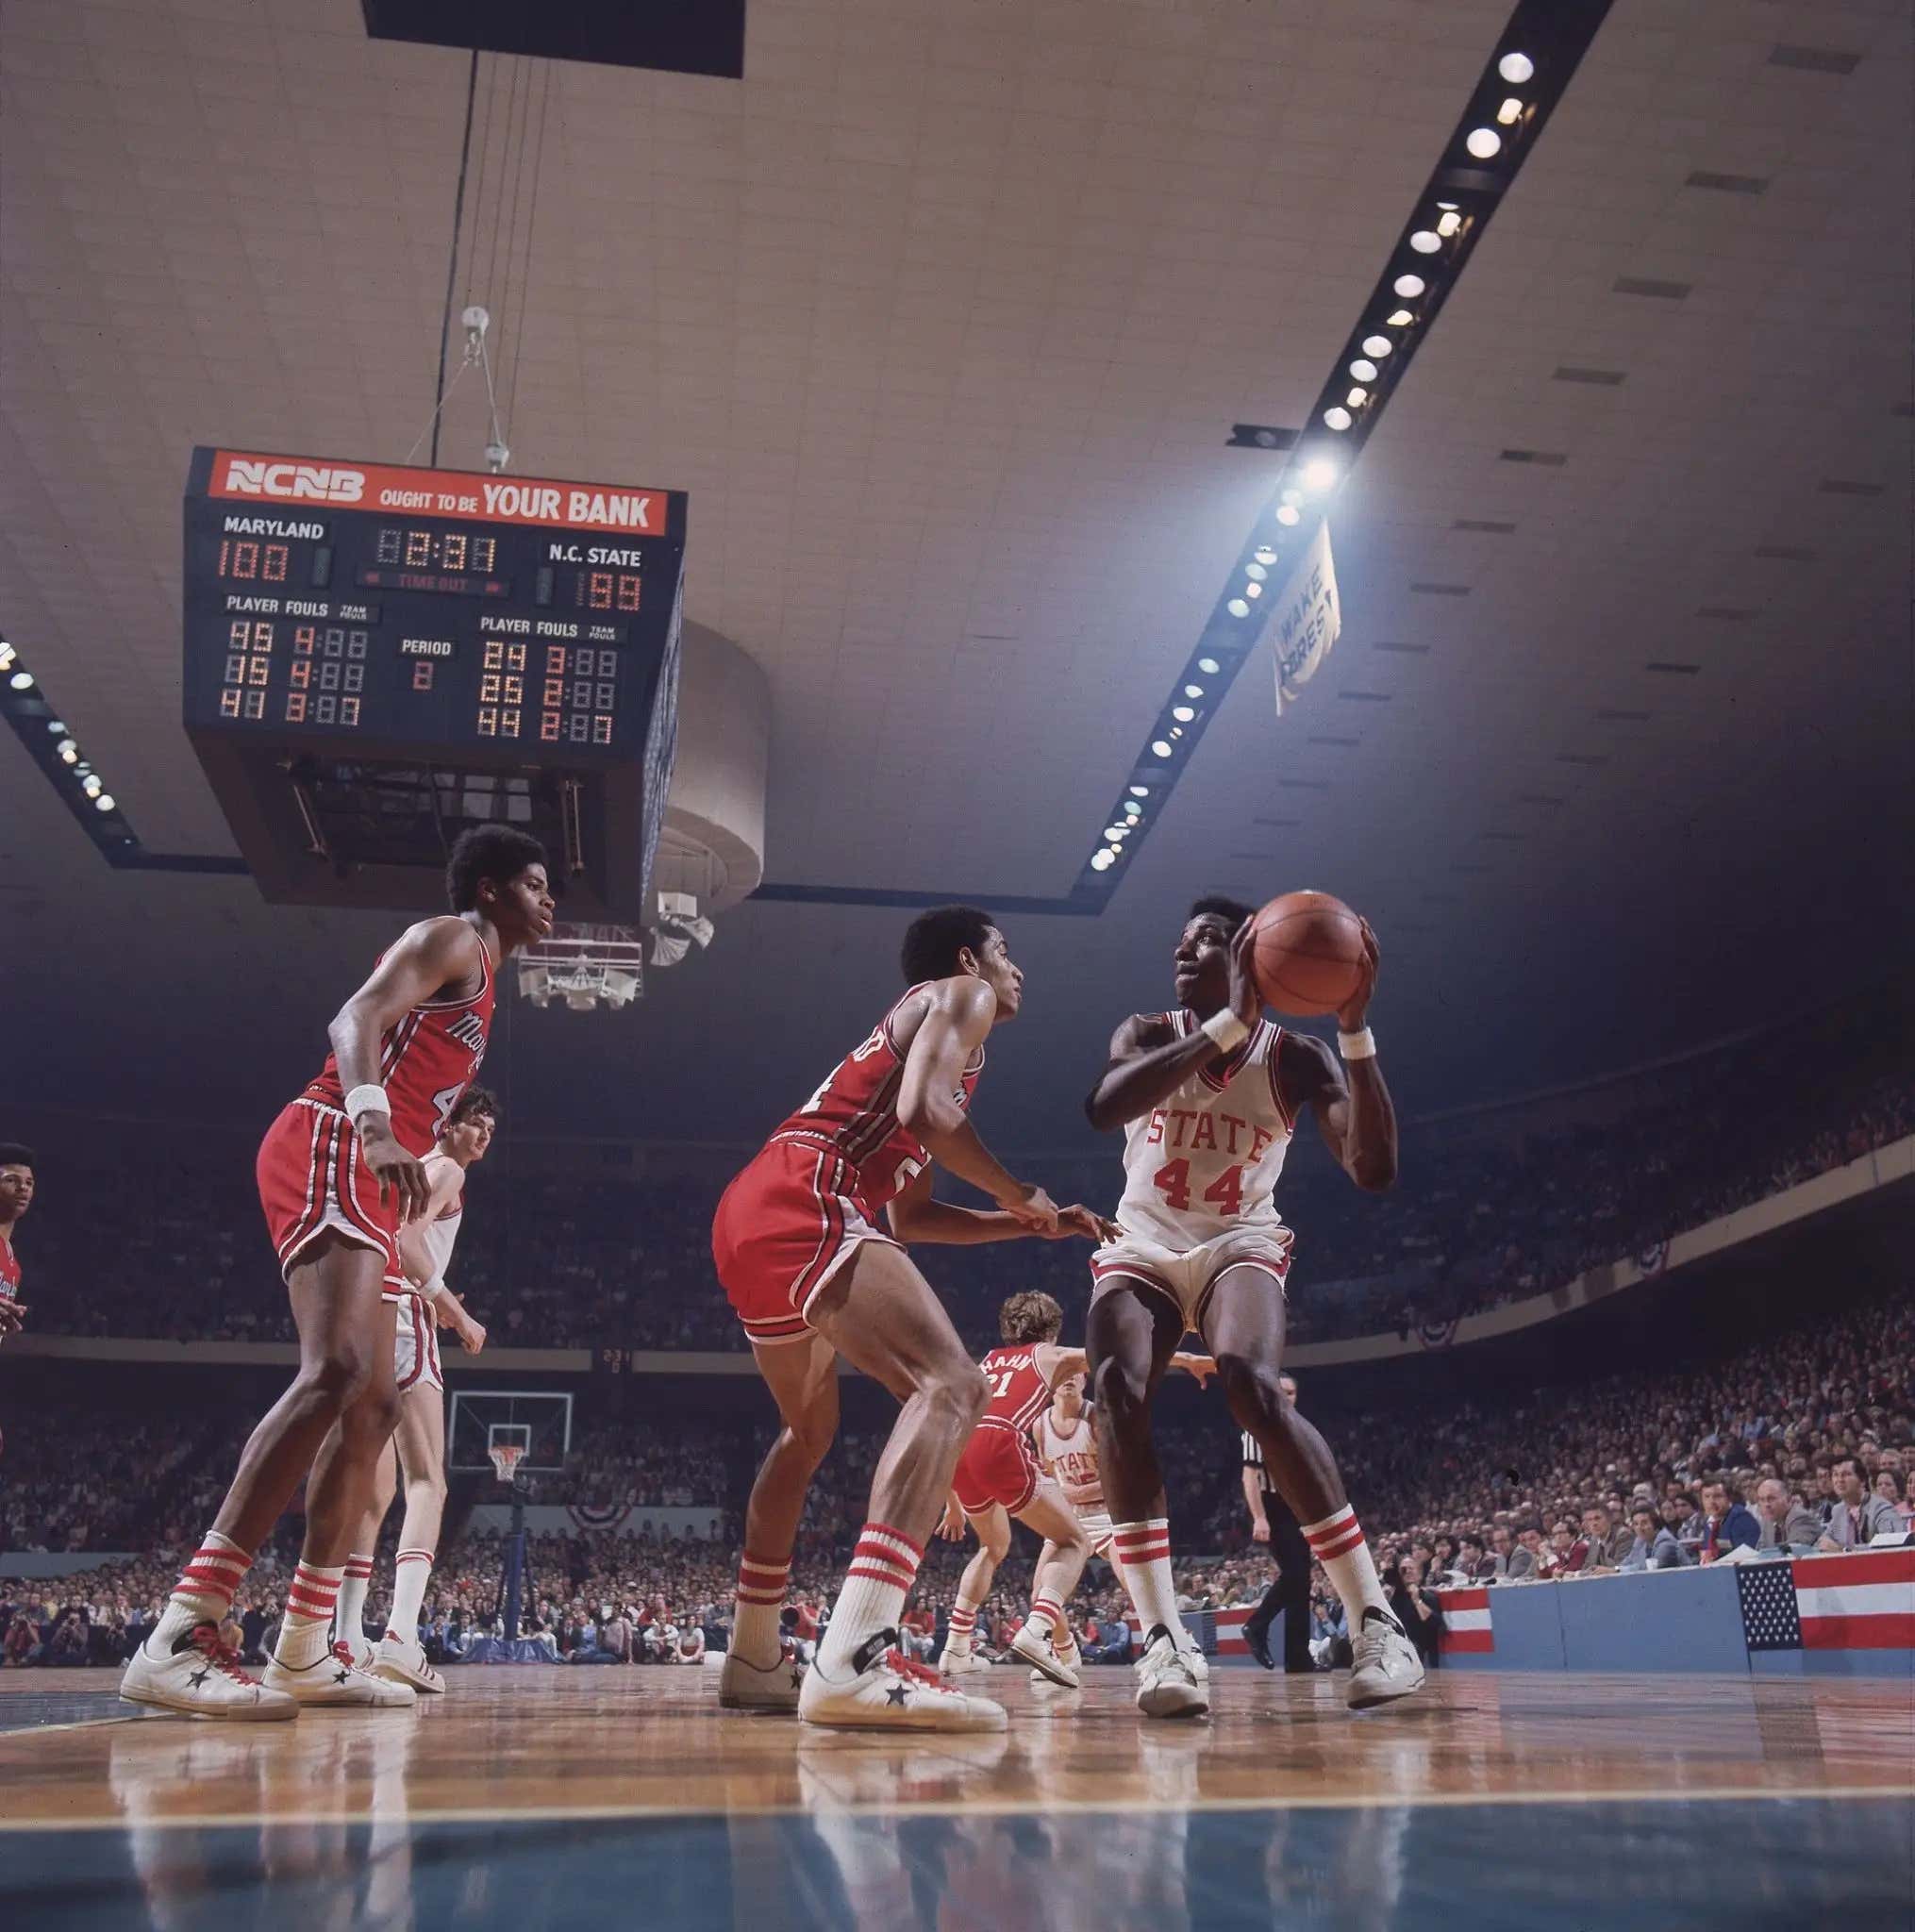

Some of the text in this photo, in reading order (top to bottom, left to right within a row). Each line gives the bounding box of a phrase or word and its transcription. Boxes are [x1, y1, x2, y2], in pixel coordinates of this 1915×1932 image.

[225, 460, 651, 527] NCNB OUGHT TO BE YOUR BANK
[224, 516, 325, 540] MARYLAND
[218, 541, 289, 581] 100
[549, 543, 642, 567] N.C. STATE
[226, 595, 329, 617] PLAYER FOULS
[480, 616, 578, 637] PLAYER FOULS
[402, 639, 452, 656] PERIOD
[1147, 1108, 1274, 1164] STATE
[1153, 1157, 1245, 1217] 44
